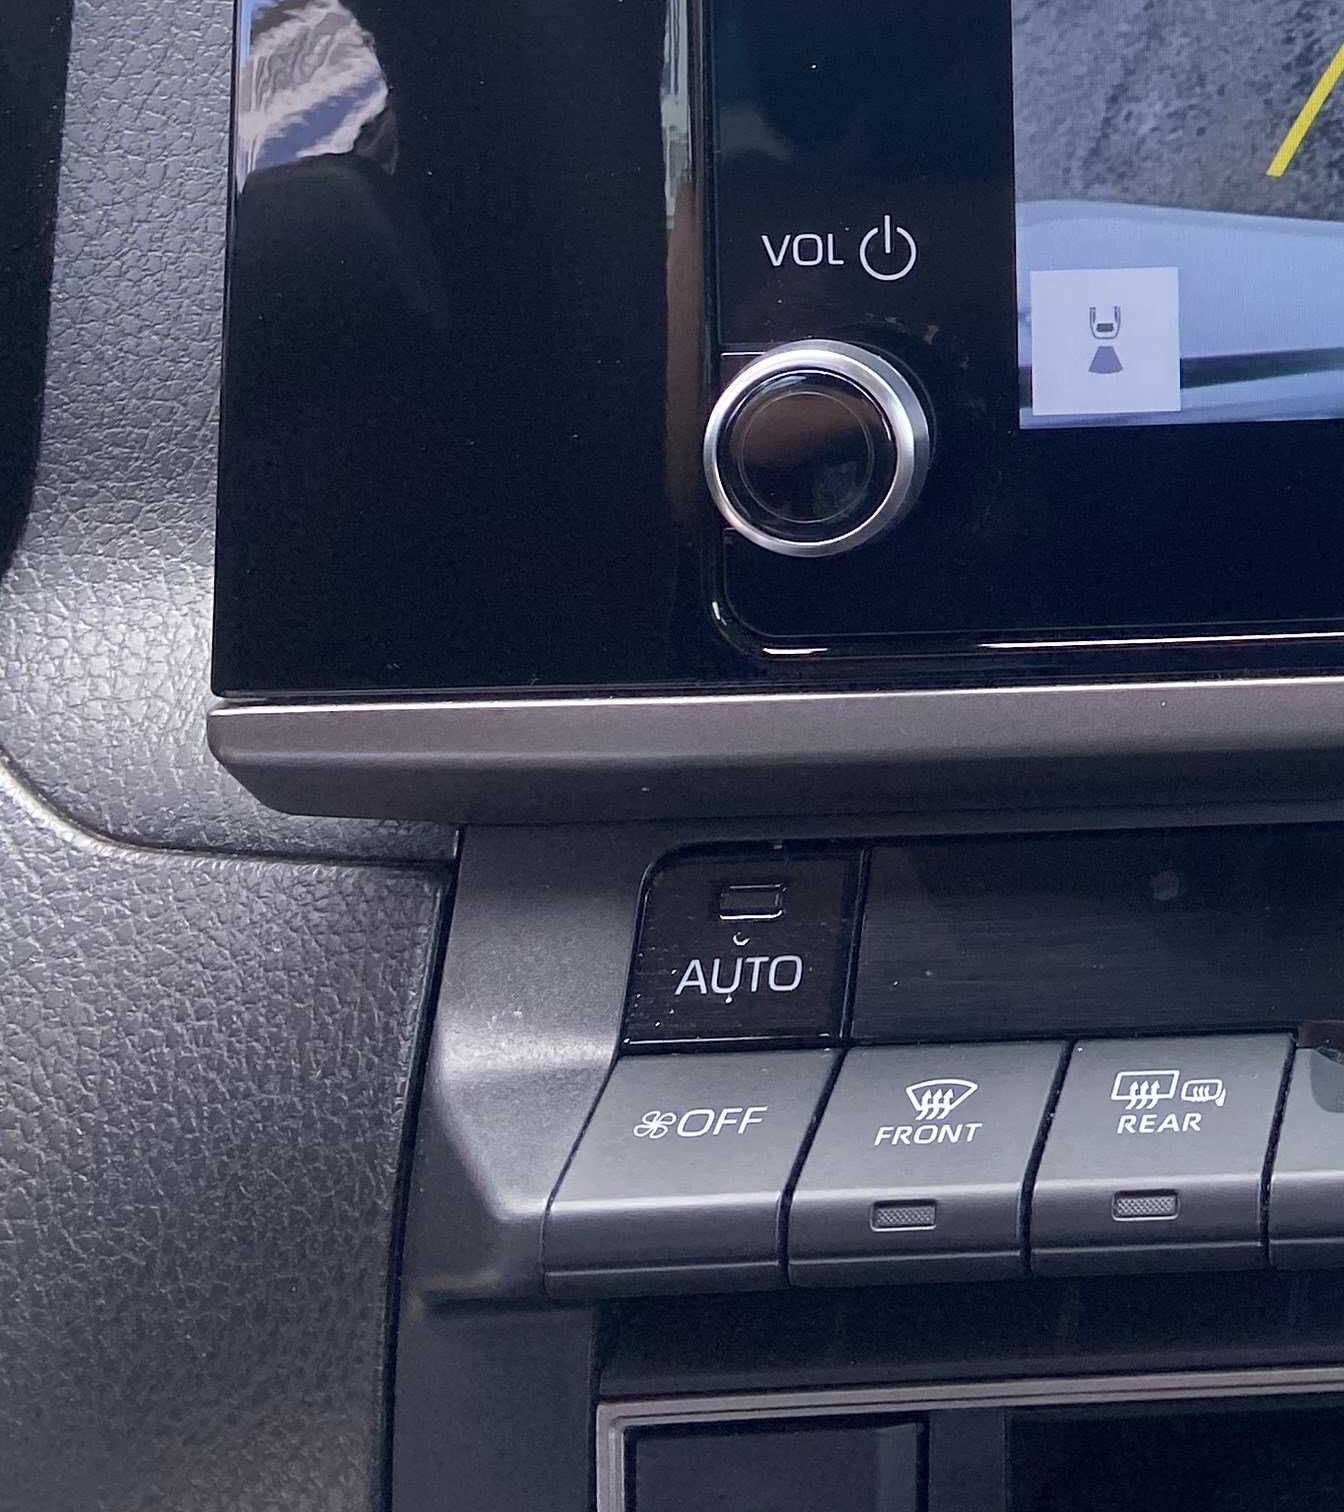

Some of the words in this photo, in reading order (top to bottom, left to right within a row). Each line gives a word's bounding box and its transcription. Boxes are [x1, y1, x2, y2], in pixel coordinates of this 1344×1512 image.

[761, 233, 845, 267] VOL
[674, 955, 803, 996] AUTO
[676, 1105, 768, 1138] OFF
[873, 1122, 984, 1146] FRONT
[1116, 1112, 1203, 1135] REAR
